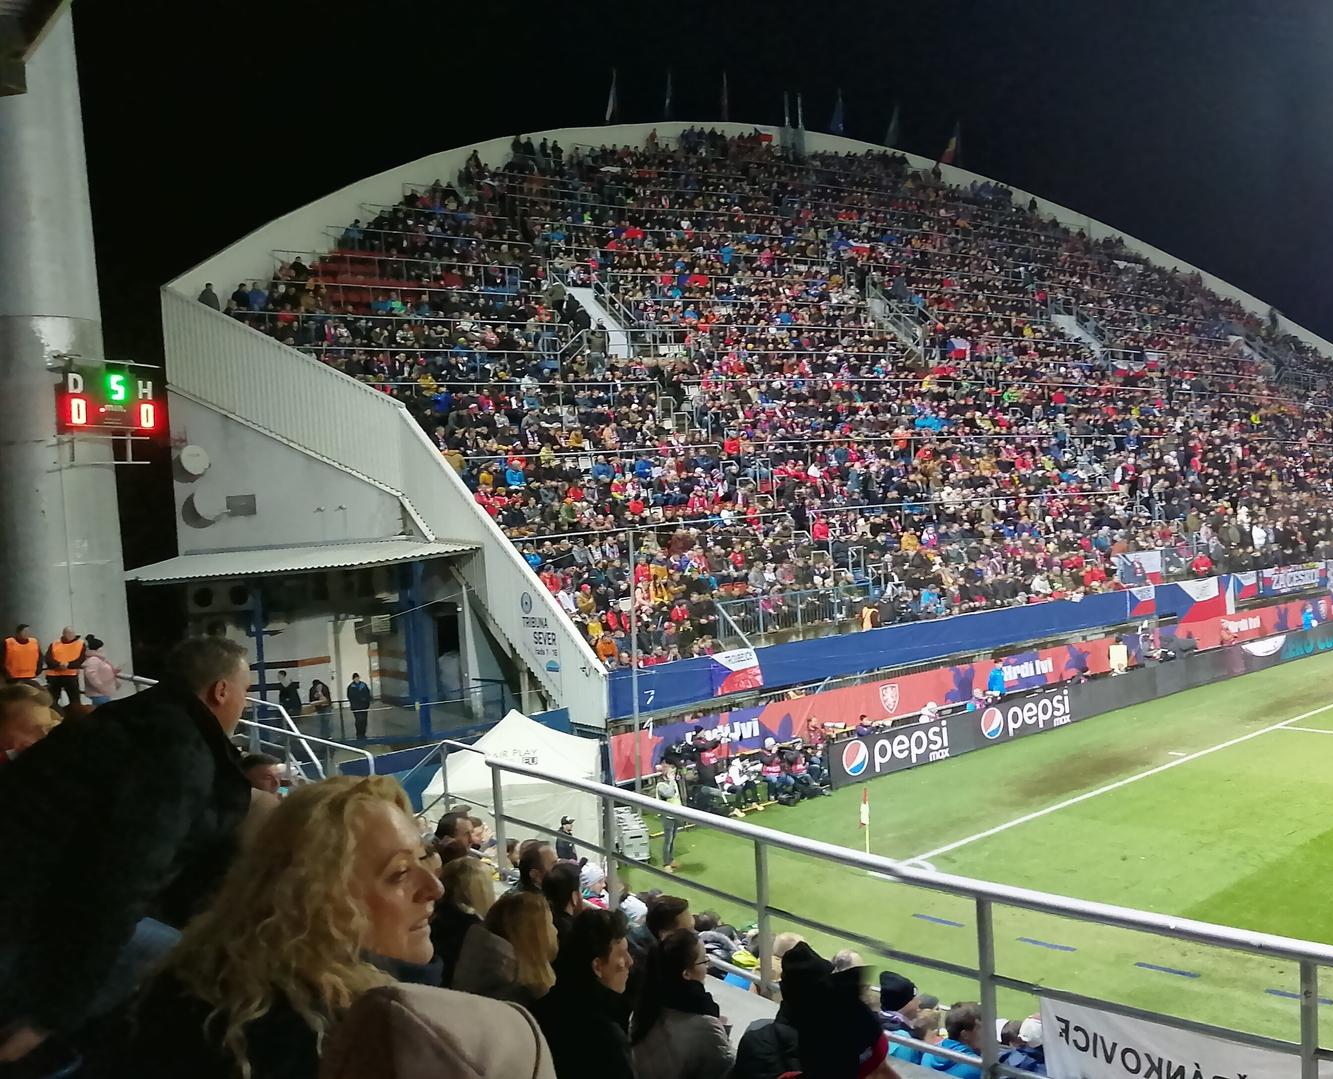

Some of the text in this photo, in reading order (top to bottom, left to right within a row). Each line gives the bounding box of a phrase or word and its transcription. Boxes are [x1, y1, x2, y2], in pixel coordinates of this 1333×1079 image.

[68, 372, 84, 393] D
[109, 374, 125, 400] 5
[137, 380, 152, 400] H
[71, 398, 87, 424] 0
[140, 403, 154, 428] 0
[533, 631, 557, 646] SEVER
[1006, 687, 1071, 737] pepsi
[874, 719, 948, 772] pepsi
[929, 747, 950, 762] max
